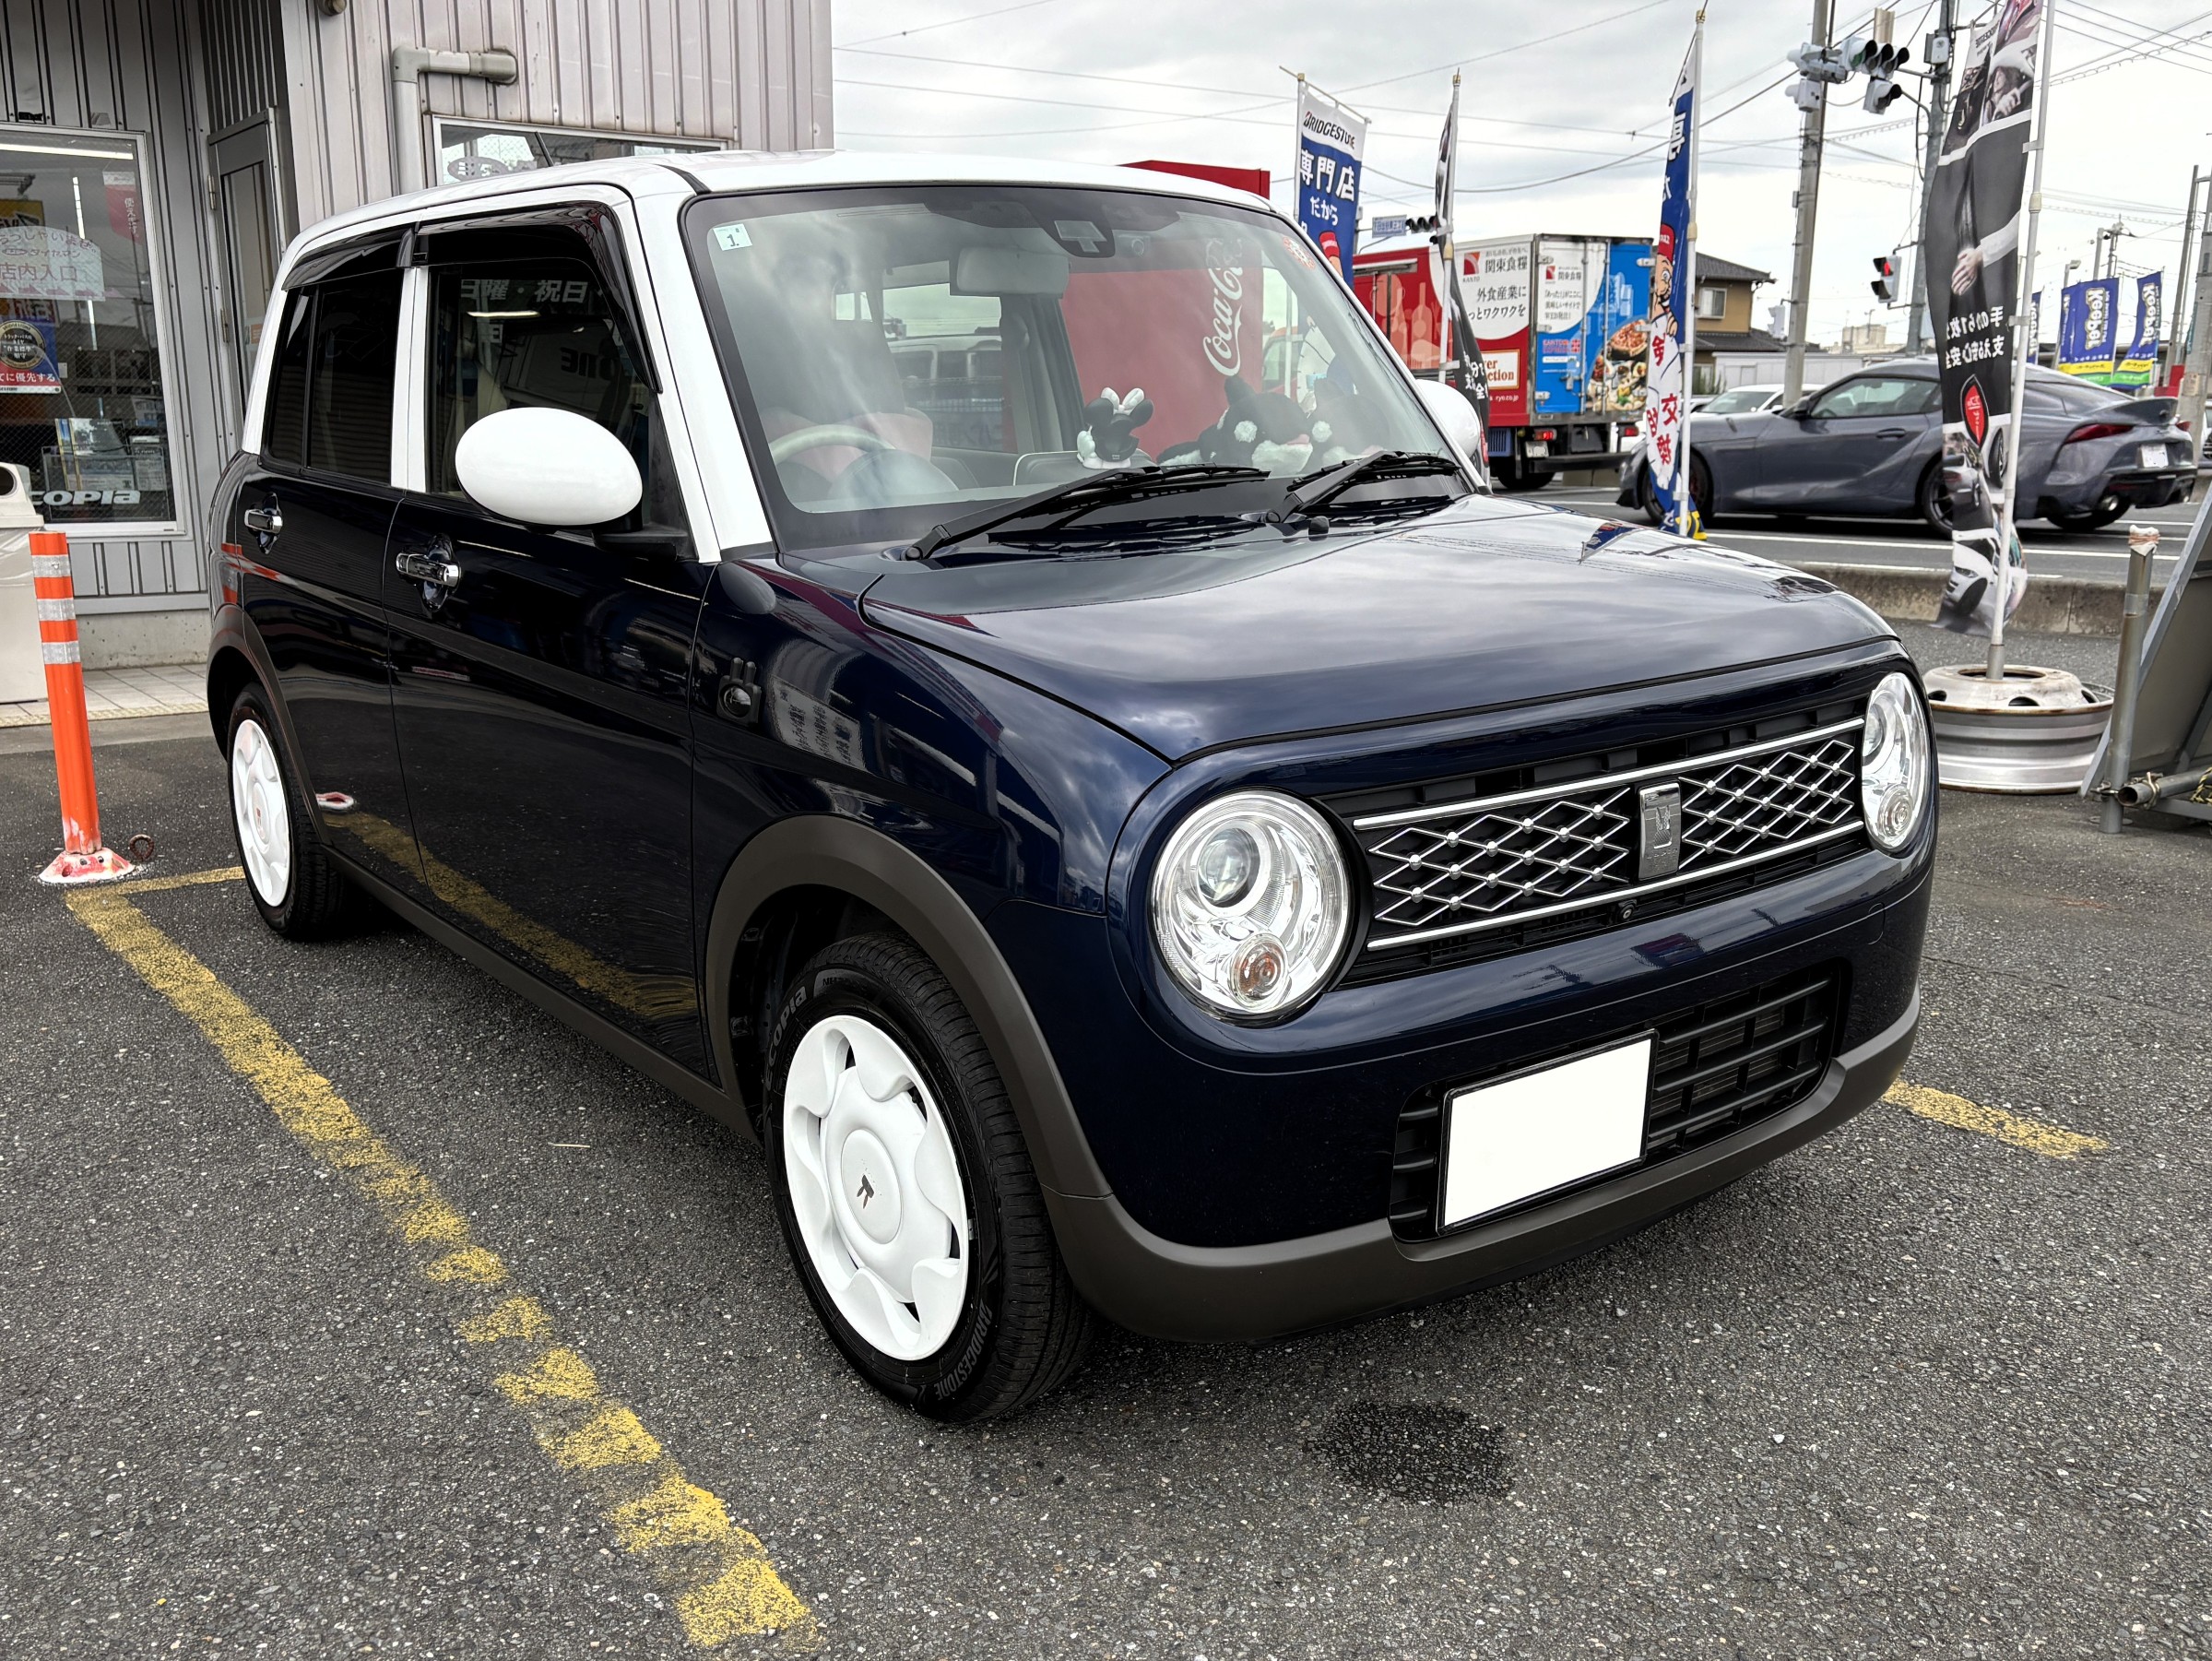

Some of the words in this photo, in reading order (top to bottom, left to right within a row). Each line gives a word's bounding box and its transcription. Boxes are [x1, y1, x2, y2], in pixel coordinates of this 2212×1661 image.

[1300, 148, 1355, 202] 専門店
[1309, 196, 1339, 226] だから
[1476, 284, 1527, 303] 外食産業に
[933, 1298, 993, 1401] BRIDGESTONE
